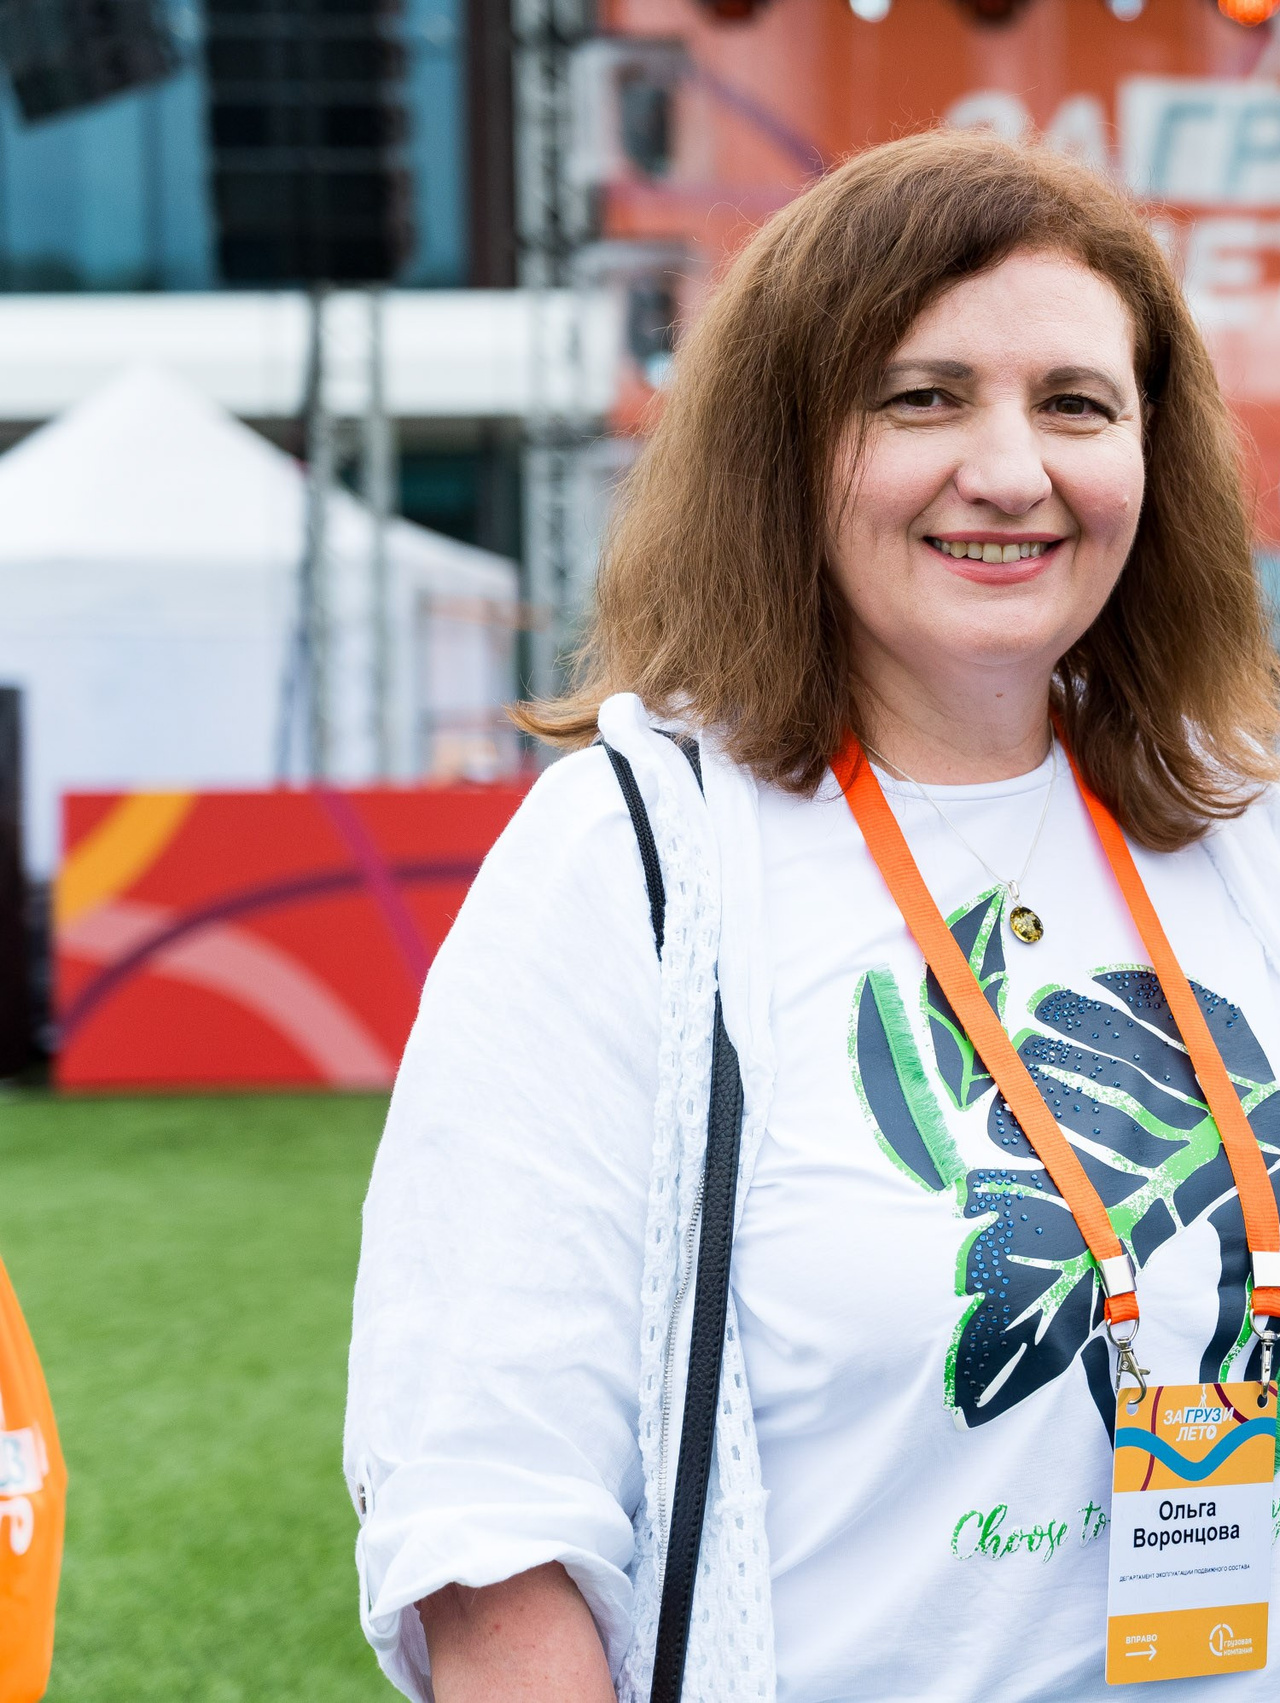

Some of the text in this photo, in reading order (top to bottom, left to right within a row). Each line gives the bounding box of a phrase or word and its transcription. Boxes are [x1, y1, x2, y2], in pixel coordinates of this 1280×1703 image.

[1163, 1406, 1235, 1425] ЗАГРУЗИ
[1175, 1425, 1217, 1442] ЛЕТО
[1159, 1500, 1217, 1521] Ольга
[950, 1500, 1112, 1563] Choose to
[1133, 1524, 1241, 1551] Воронцова
[1228, 1564, 1250, 1572] СОСТАВА
[1125, 1634, 1158, 1645] ВПРАВО
